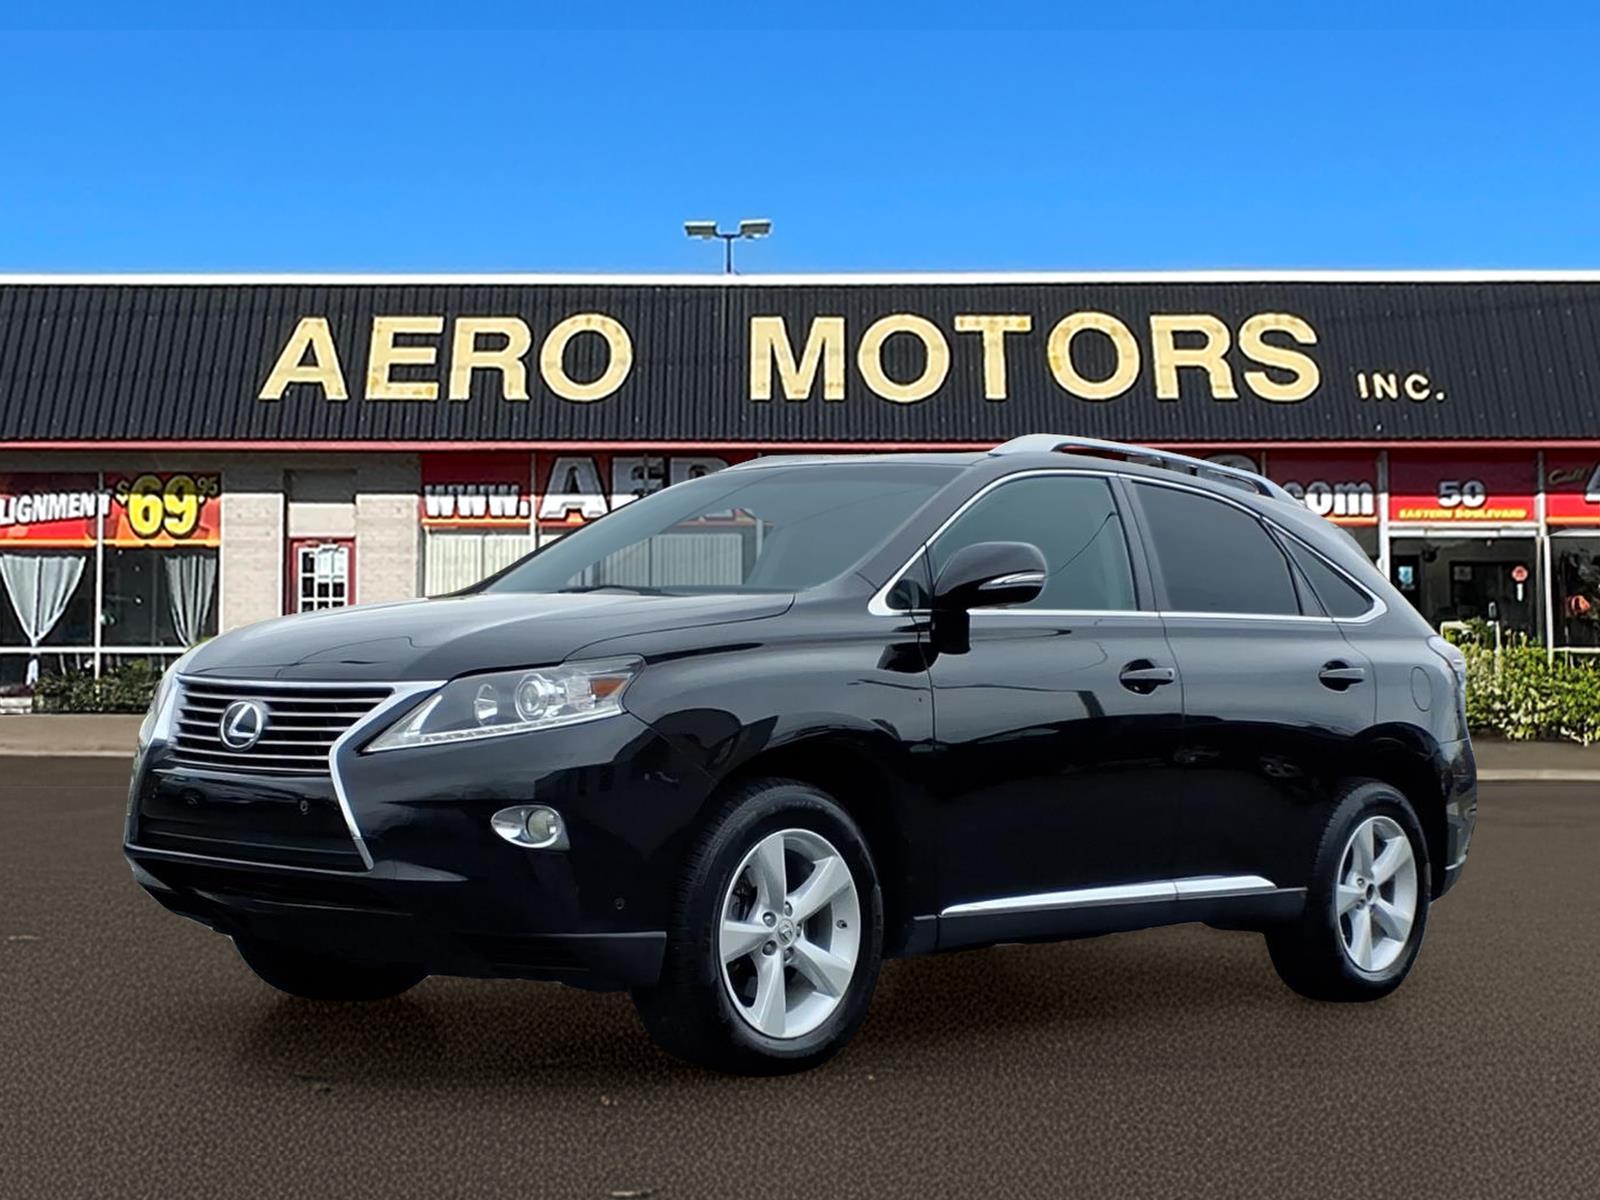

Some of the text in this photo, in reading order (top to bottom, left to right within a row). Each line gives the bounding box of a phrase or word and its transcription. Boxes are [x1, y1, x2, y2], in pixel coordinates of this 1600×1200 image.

[258, 312, 1445, 404] AERO MOTORS INC.
[1438, 480, 1485, 508] 50
[1399, 508, 1527, 520] EASTERN BOULEVARD
